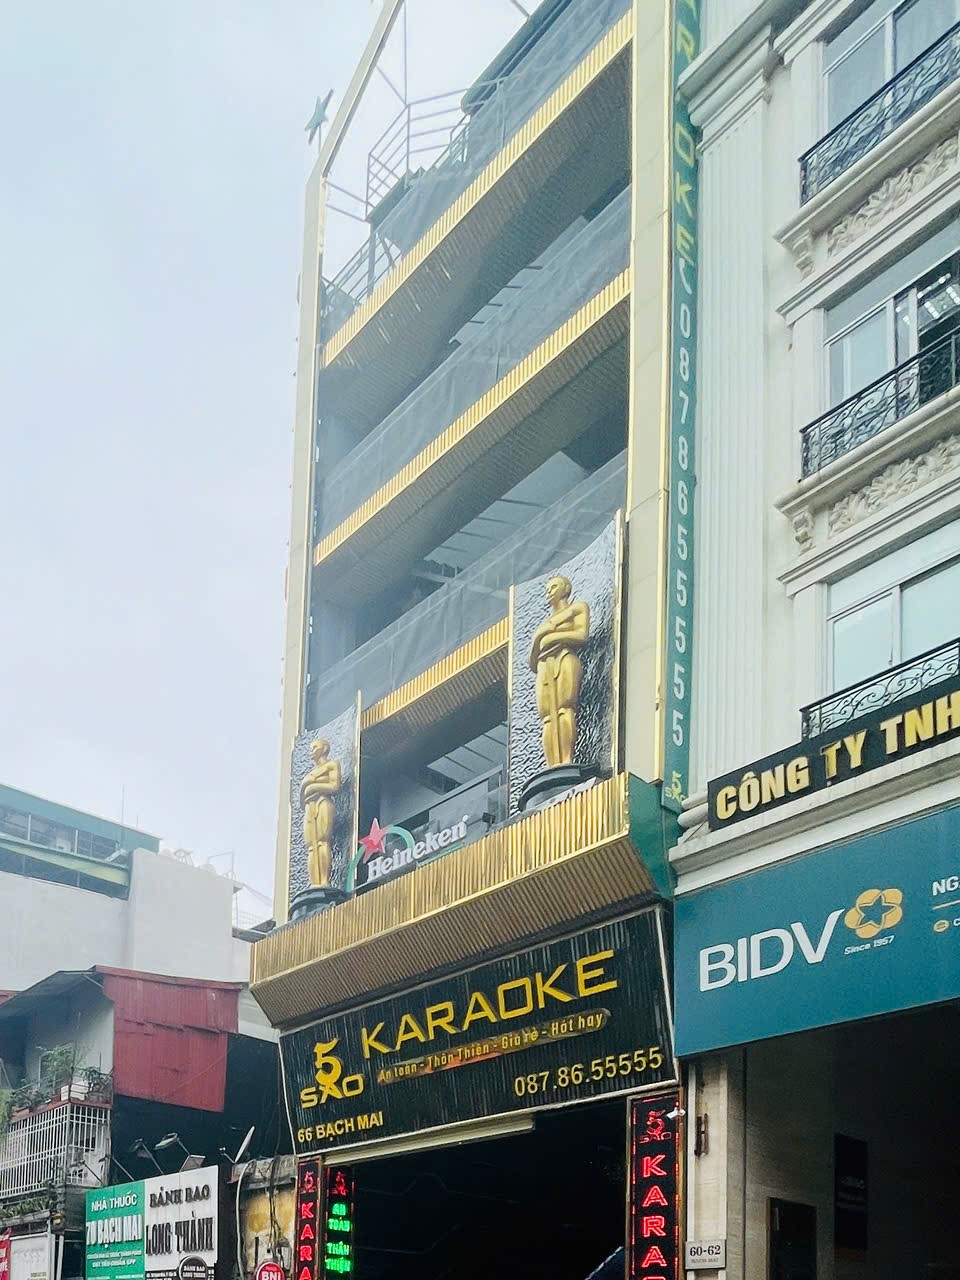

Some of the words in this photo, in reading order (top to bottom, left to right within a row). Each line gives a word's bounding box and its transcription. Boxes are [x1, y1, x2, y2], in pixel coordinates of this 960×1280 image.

[716, 755, 811, 820] CÔNG
[820, 729, 868, 780] TY
[367, 820, 469, 883] Heineken
[699, 908, 845, 992] BIDV
[844, 943, 871, 955] Since
[873, 935, 895, 948] 1957
[361, 949, 618, 1059] KARAOKE
[578, 1013, 603, 1033] hay
[313, 1037, 341, 1086] 5
[514, 1046, 664, 1097] 087.86.55555
[300, 1073, 365, 1109] SAO
[297, 1128, 313, 1143] 66
[316, 1118, 355, 1142] BẠCH
[357, 1111, 384, 1130] MAI
[184, 1184, 211, 1204] BAO
[145, 1222, 173, 1257] LONG
[174, 1210, 215, 1253] THÀNH
[689, 1244, 721, 1257] 60-62
